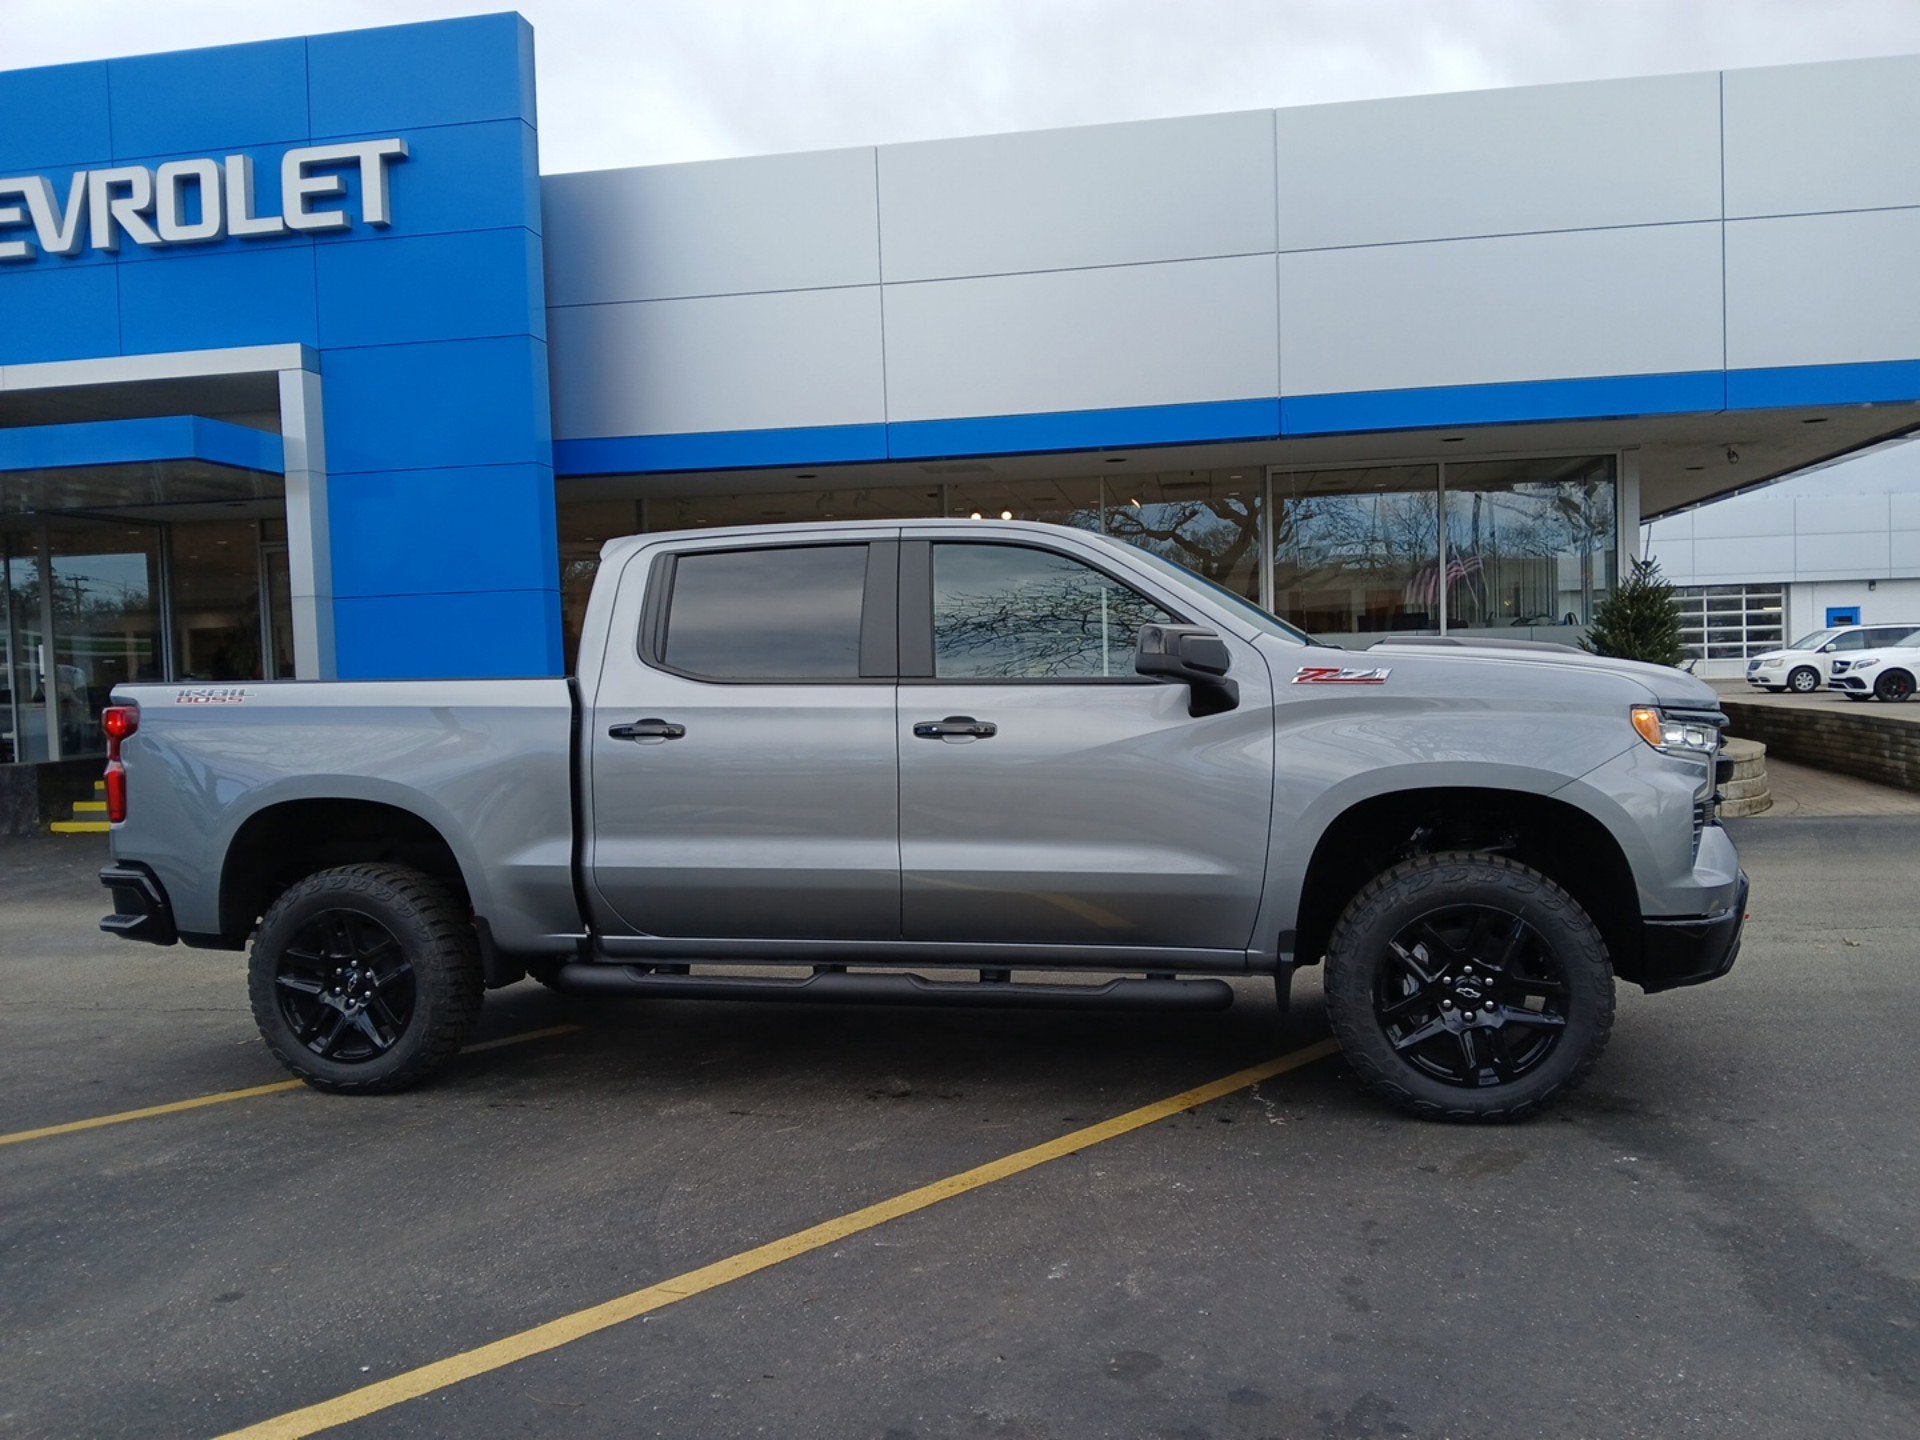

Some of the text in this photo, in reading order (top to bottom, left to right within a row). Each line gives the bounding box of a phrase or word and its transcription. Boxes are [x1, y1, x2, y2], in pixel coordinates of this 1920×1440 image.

[1291, 667, 1393, 684] Z71
[178, 687, 256, 697] TRAIL
[176, 696, 245, 705] BOSS
